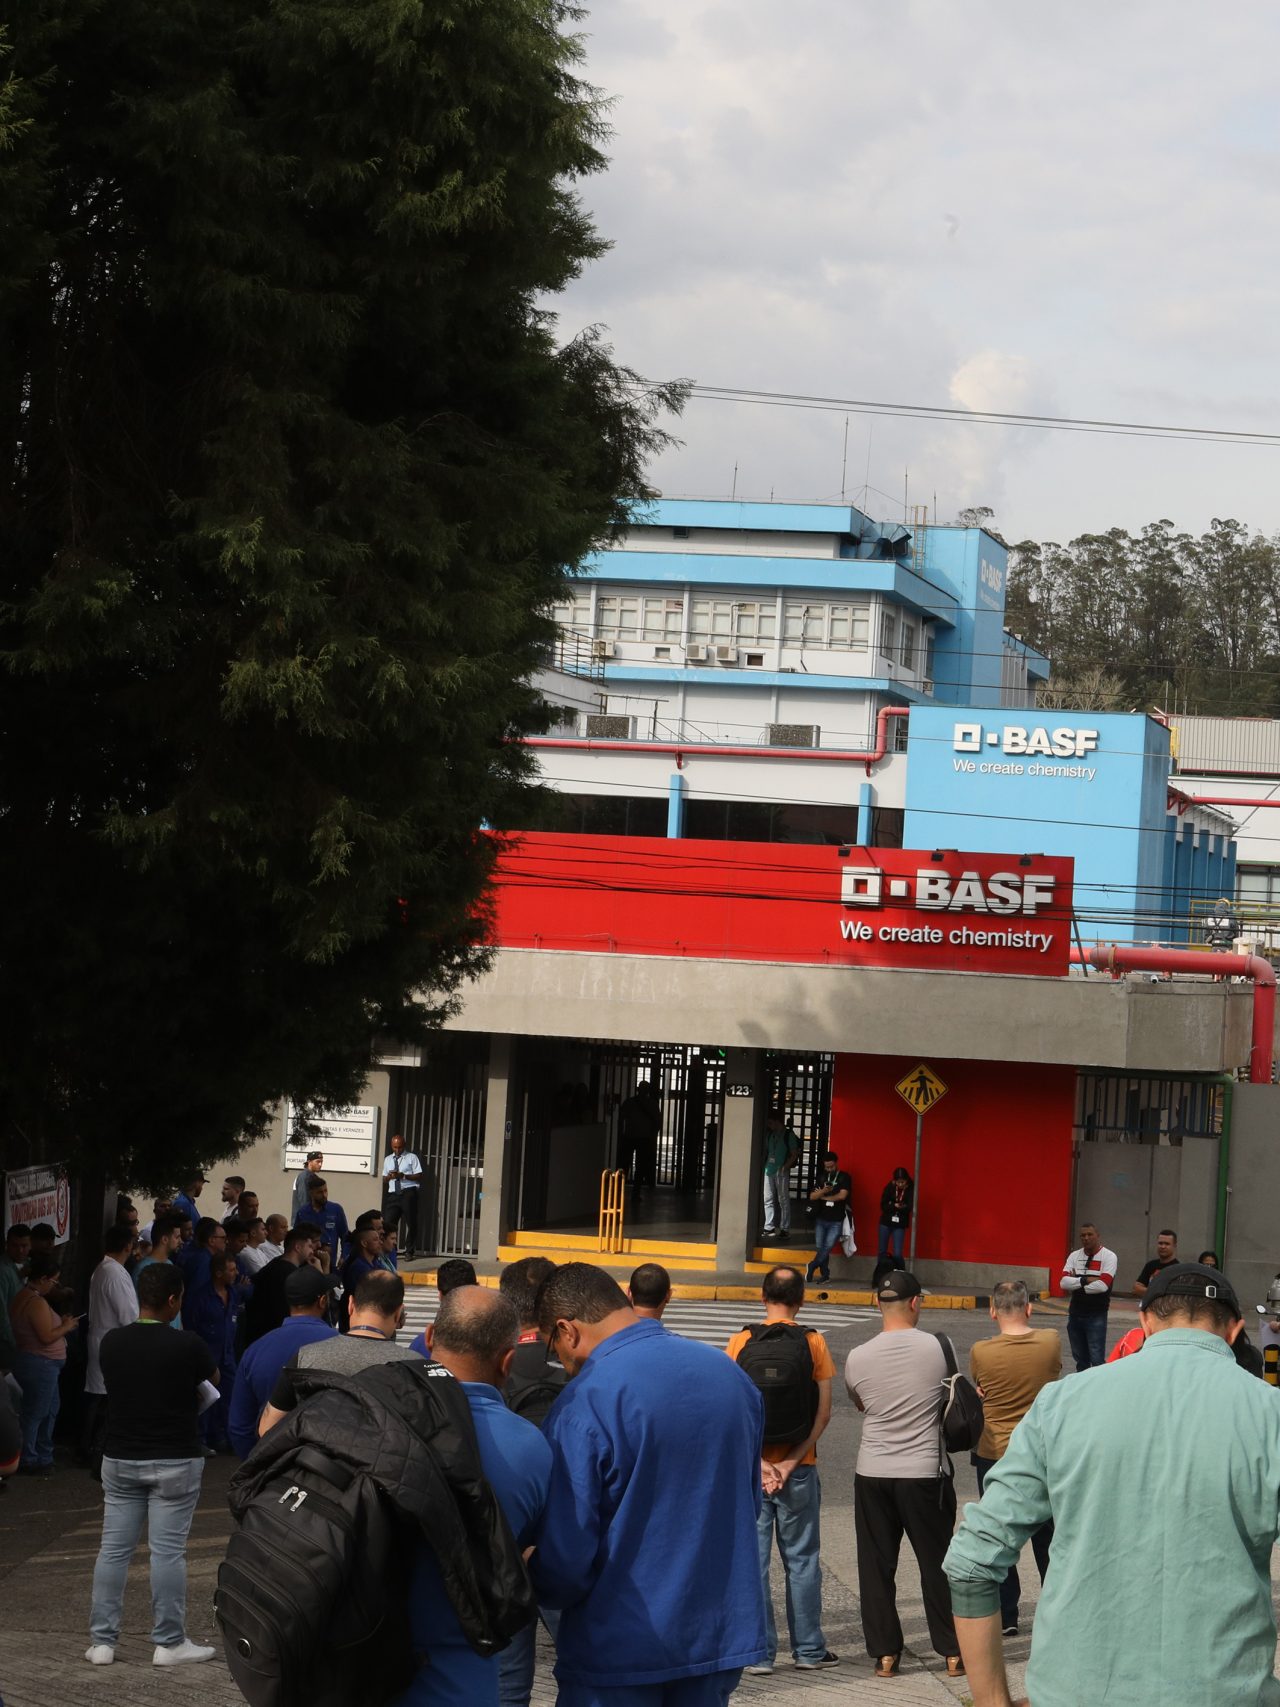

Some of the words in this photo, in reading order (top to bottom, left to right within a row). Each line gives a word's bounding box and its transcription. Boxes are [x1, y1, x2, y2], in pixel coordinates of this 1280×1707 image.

[1003, 726, 1098, 758] BASF
[953, 759, 976, 773] We
[980, 762, 1024, 775] create
[1028, 762, 1096, 780] chemistry
[916, 869, 1056, 915] BASF
[840, 920, 873, 941] We
[879, 924, 943, 944] create
[949, 926, 1053, 952] chemistry
[730, 1085, 750, 1096] 123
